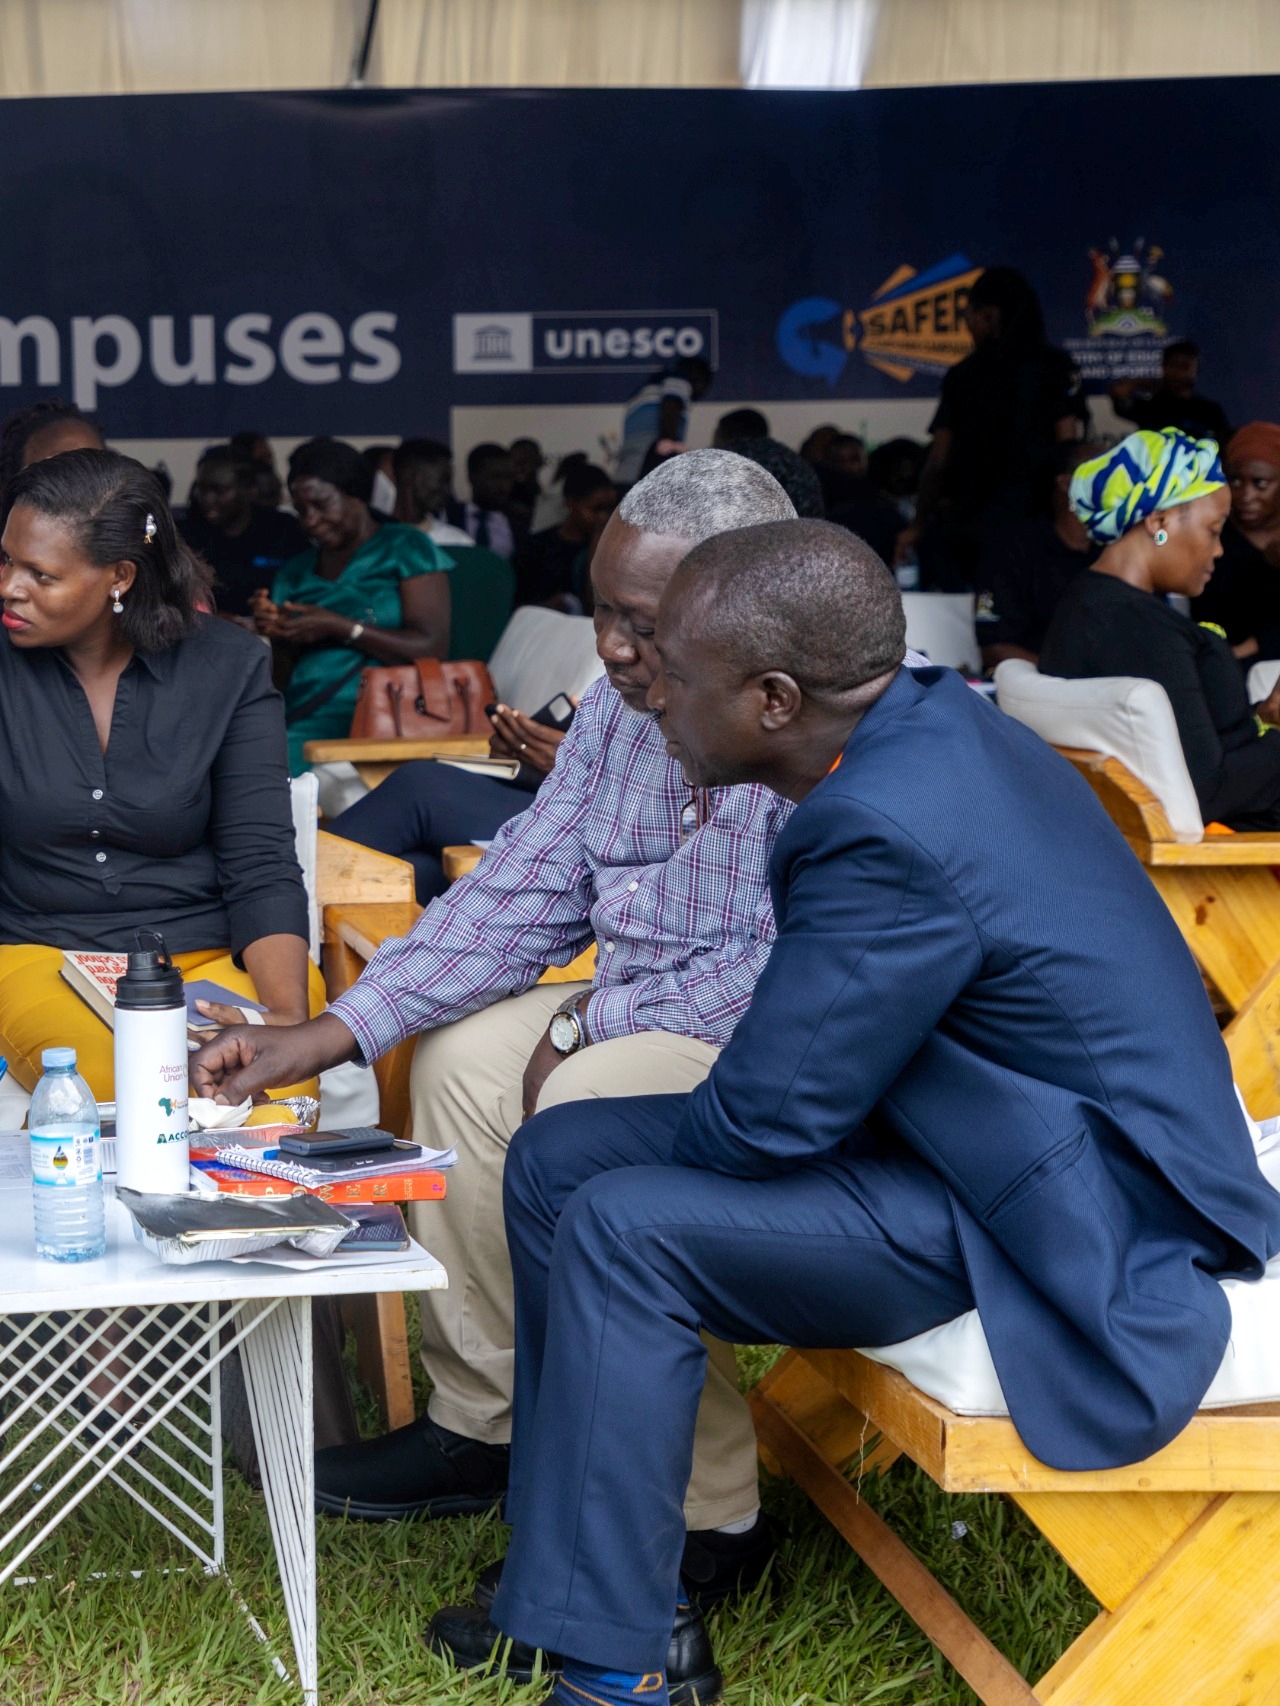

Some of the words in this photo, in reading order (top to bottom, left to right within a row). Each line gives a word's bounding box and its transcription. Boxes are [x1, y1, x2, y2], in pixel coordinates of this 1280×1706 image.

[870, 287, 972, 335] SAFER
[544, 326, 704, 359] unesco
[159, 1064, 183, 1073] African
[163, 1073, 184, 1082] Union
